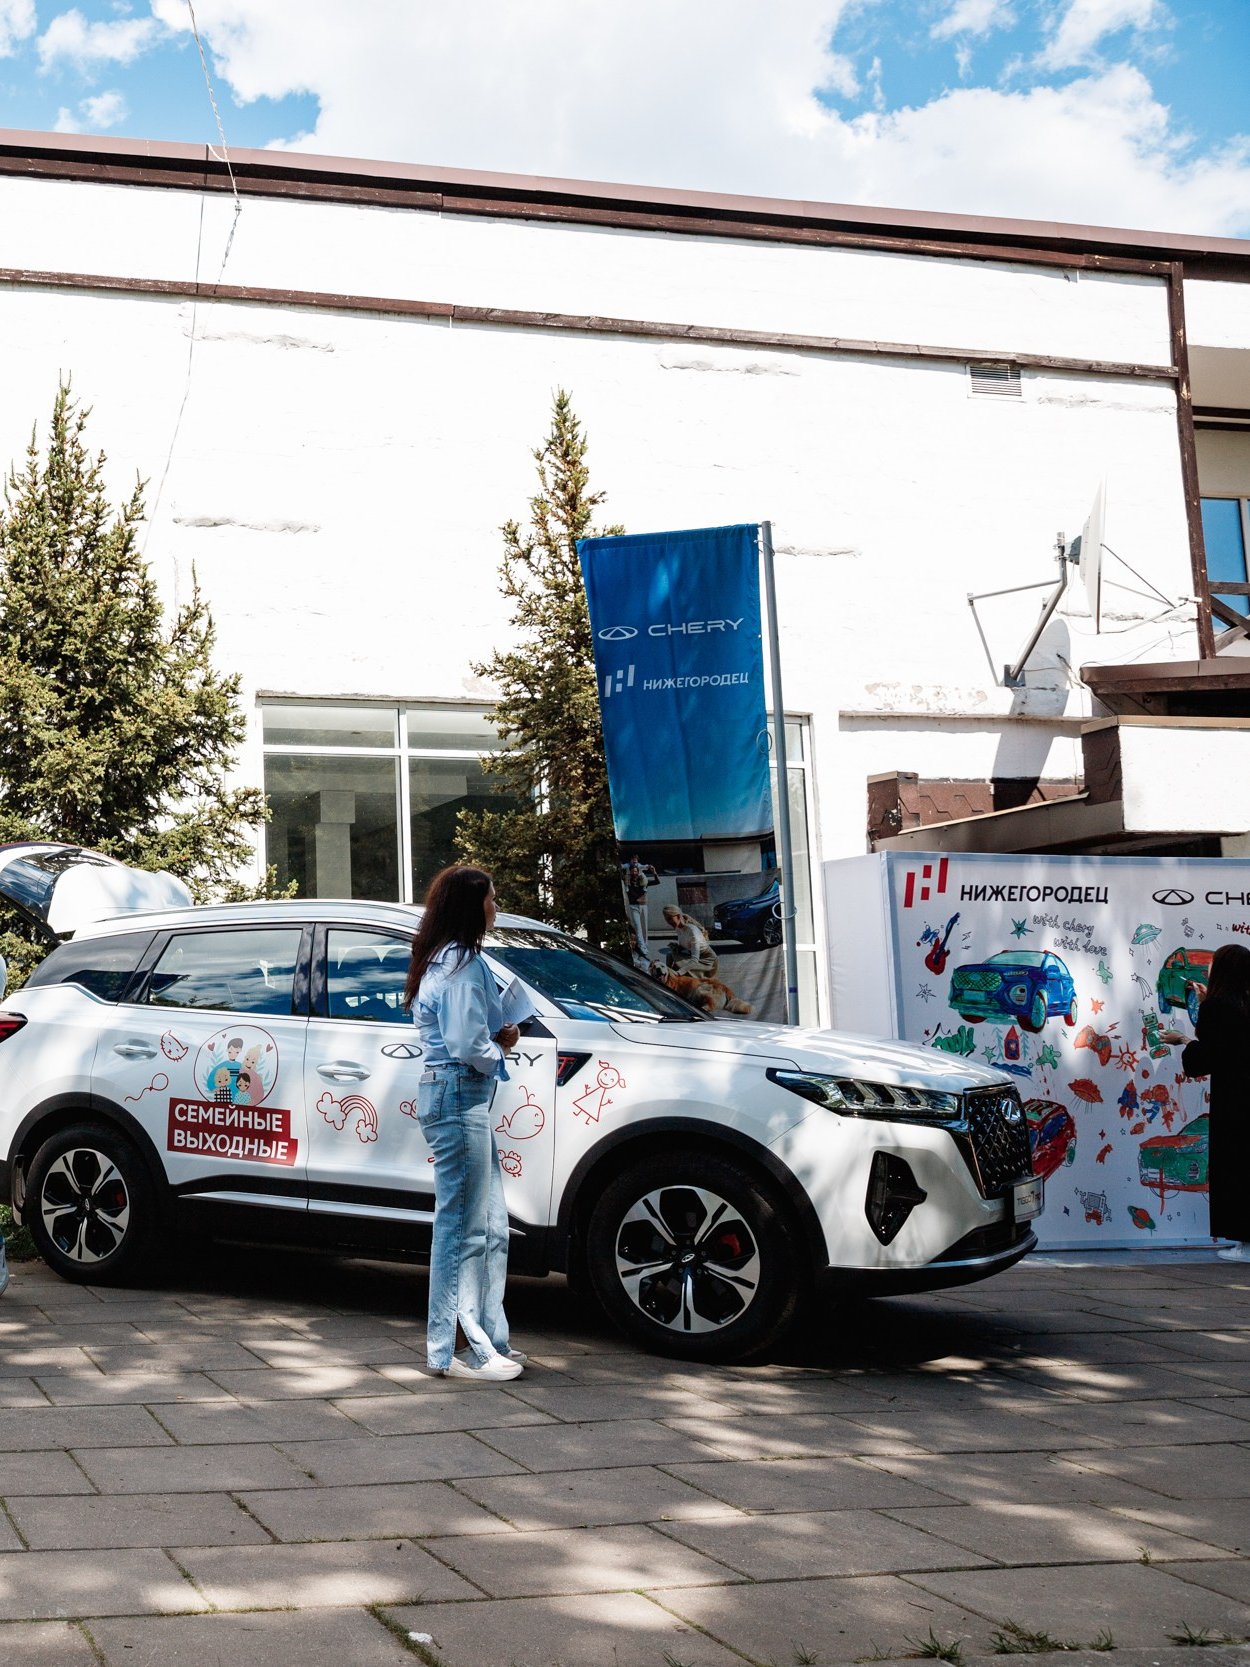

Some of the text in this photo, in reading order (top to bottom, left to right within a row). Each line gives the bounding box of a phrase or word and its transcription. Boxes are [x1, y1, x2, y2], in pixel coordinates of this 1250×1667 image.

[648, 618, 744, 636] CHERY
[643, 672, 749, 690] НИЖЕГОРОДЕЦ
[960, 884, 1109, 904] НИЖЕГОРОДЕЦ
[1033, 913, 1060, 929] with
[1054, 936, 1108, 956] with love
[175, 1104, 283, 1132] СЕМЕЙНЫЕ
[174, 1129, 289, 1160] ВЫХОДНЫЕ
